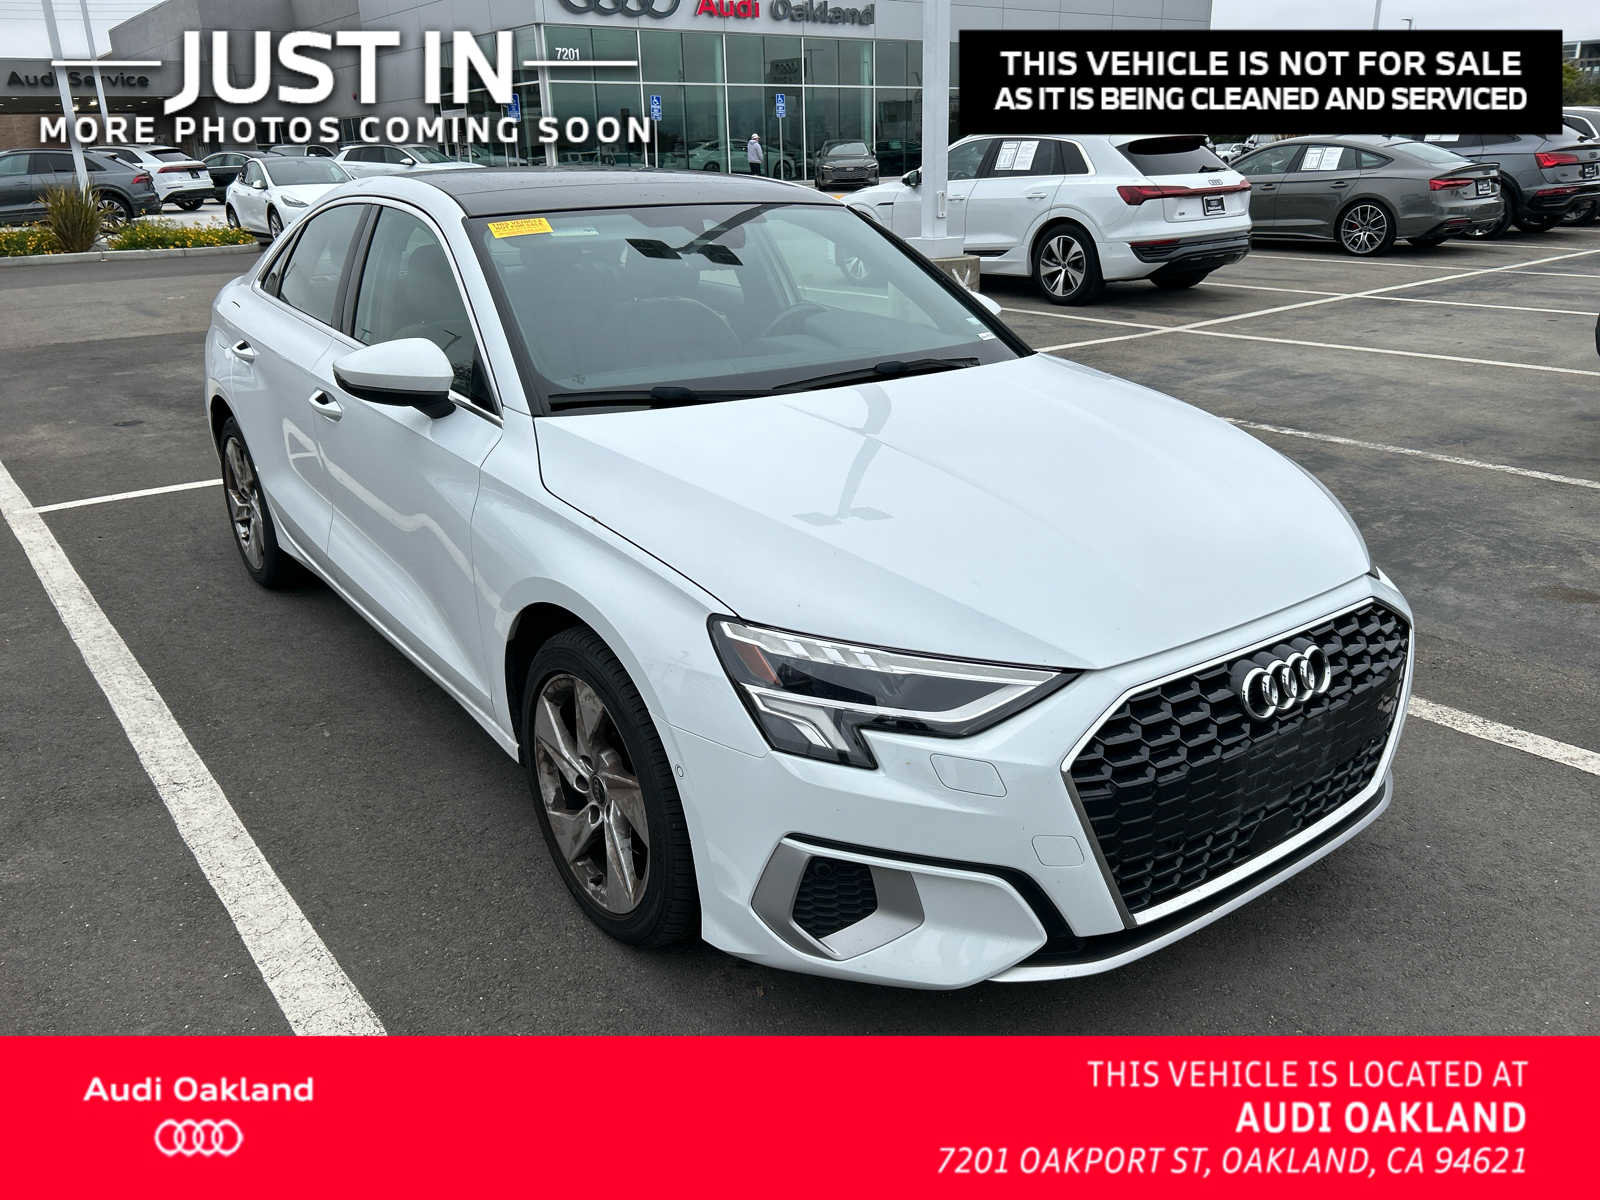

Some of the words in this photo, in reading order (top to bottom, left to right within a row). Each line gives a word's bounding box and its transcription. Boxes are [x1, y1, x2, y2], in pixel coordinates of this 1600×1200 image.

[694, 0, 760, 18] Audi
[770, 0, 876, 26] Oakland
[555, 47, 580, 61] 7201
